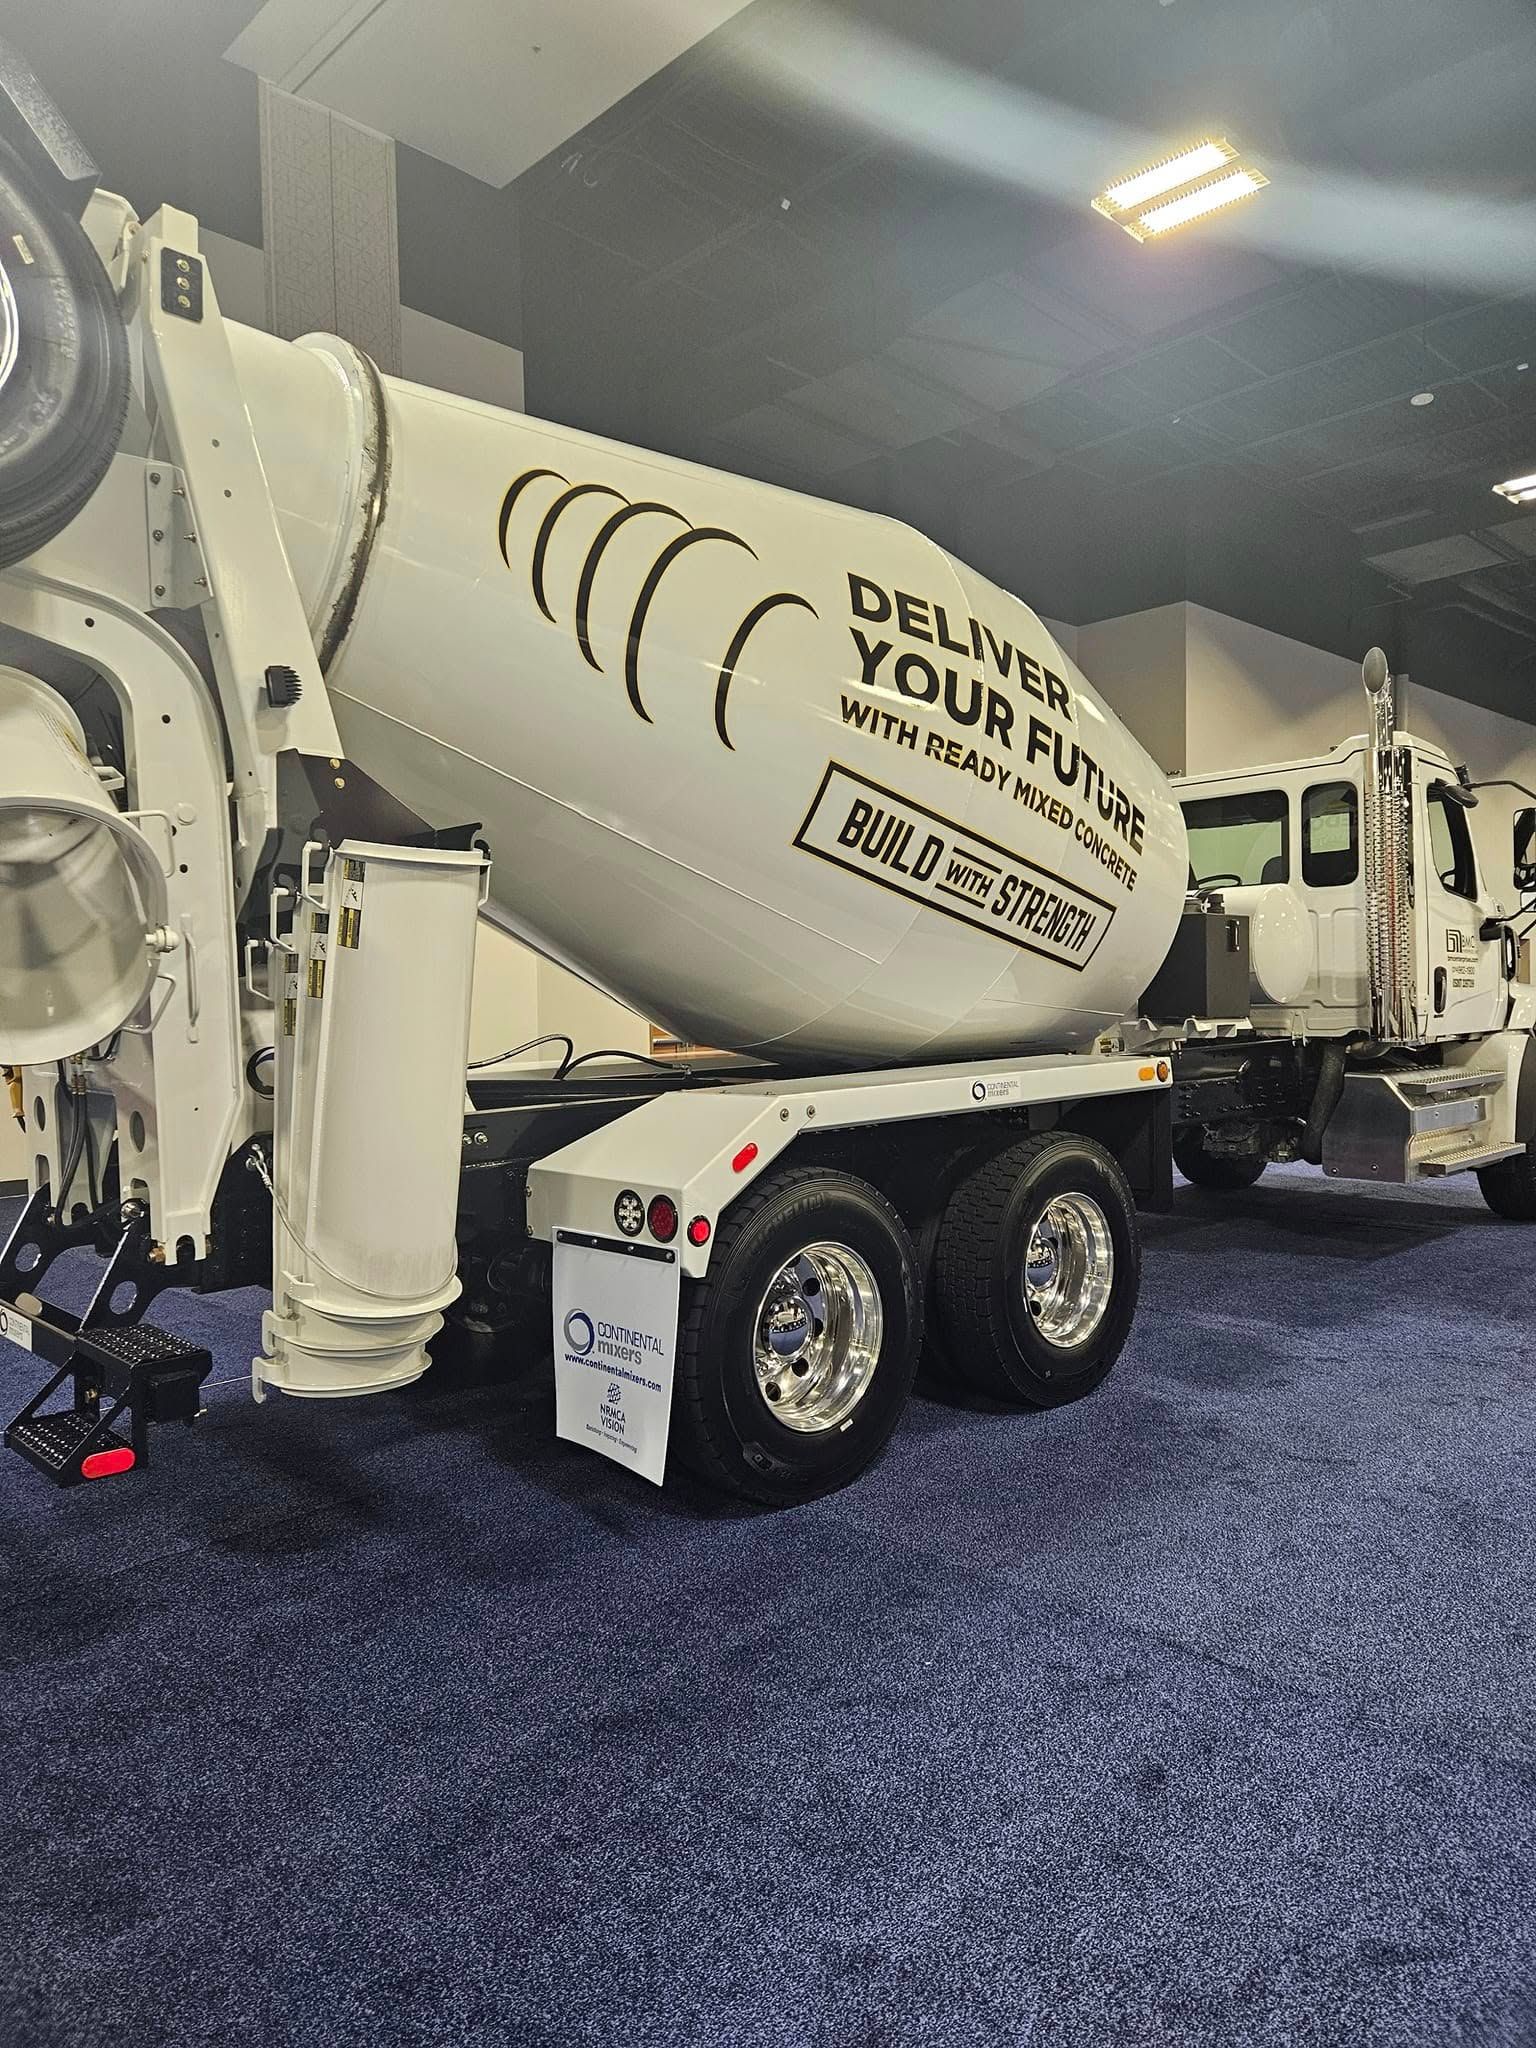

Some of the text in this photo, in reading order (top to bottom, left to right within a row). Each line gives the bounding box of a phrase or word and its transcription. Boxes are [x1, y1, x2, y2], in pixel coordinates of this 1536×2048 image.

[847, 572, 1073, 721] DELIVER
[849, 626, 1146, 856] YOUR FUTURE
[840, 695, 1138, 893] WITH READY MIXED CONCRETE
[837, 798, 1097, 954] BUILD WITH STRENGTH
[597, 1339, 642, 1365] mixers
[598, 1321, 664, 1356] CONTINENTAL
[564, 1353, 662, 1392] www.continentalmixers.com
[600, 1403, 626, 1424] NRMCA
[601, 1415, 625, 1436] VISION
